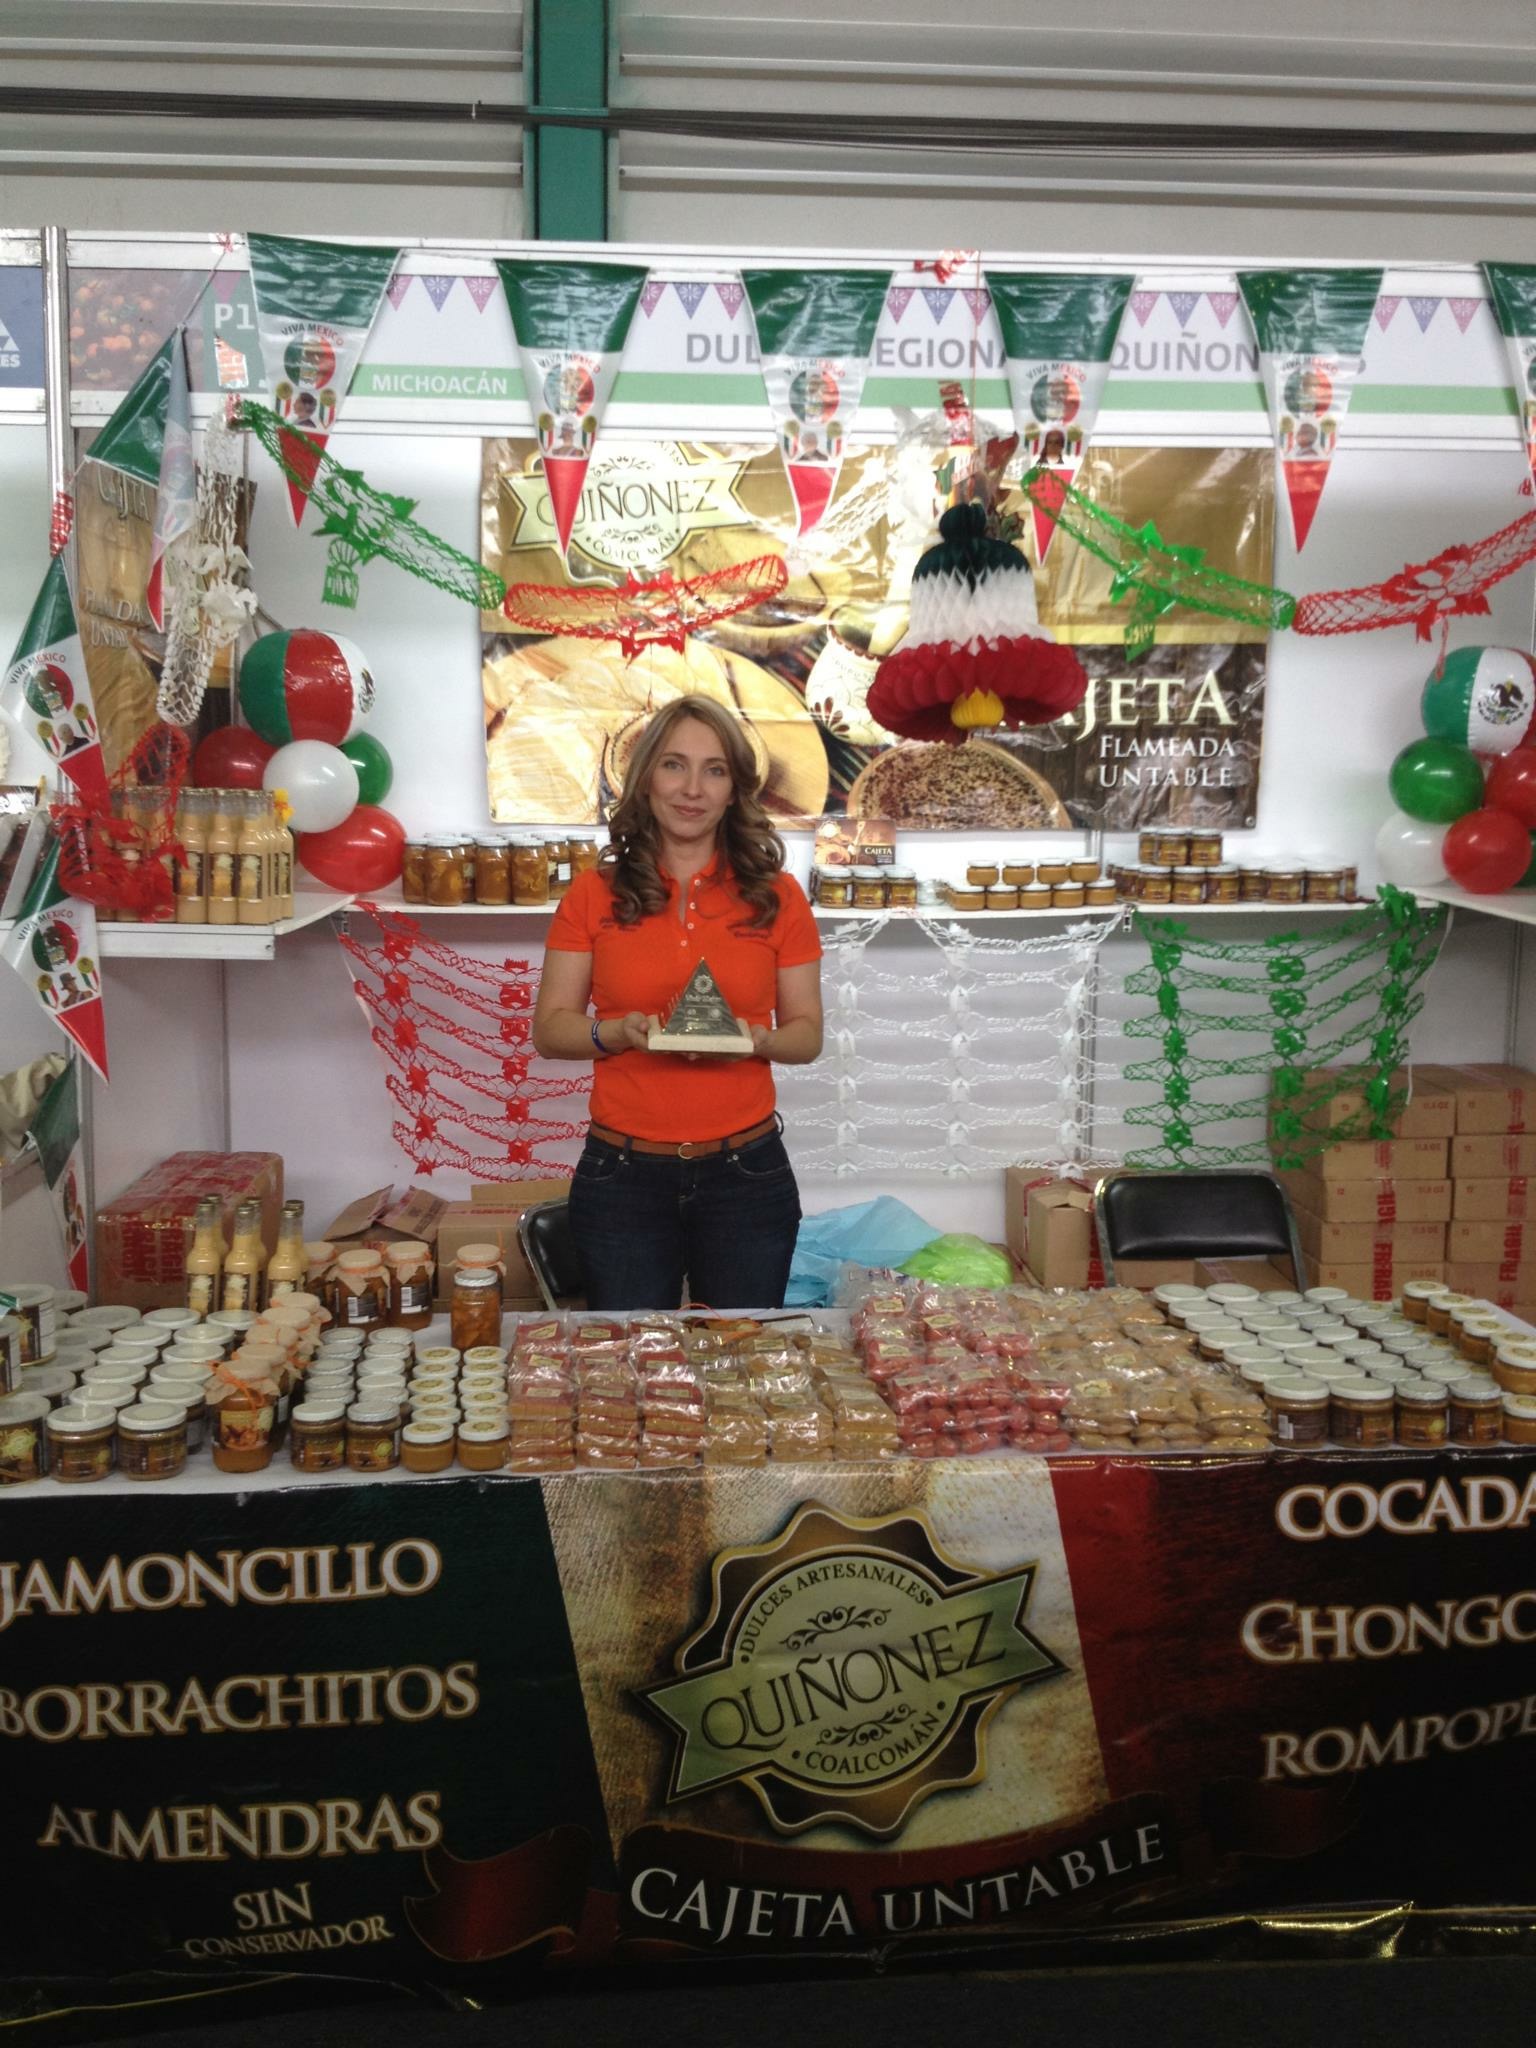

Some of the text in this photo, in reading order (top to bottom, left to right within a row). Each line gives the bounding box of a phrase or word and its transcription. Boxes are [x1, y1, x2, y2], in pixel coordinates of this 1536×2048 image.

[281, 323, 305, 336] VIVA
[371, 370, 508, 396] MICHOACÁN
[1058, 668, 1238, 742] JETA
[1099, 735, 1237, 760] FLAMEADA
[1099, 764, 1234, 788] UNTABLE
[0, 1538, 441, 1632] JAMONCILLO
[740, 1563, 929, 1654] DULCES ARTESANALES
[0, 1661, 480, 1743] BORRACHITOS
[699, 1609, 1006, 1752] QUIÑONEZ
[805, 1711, 940, 1774] COALCOMÁN
[38, 1790, 442, 1862] ALMENDRAS
[232, 1882, 313, 1931] SIN
[630, 1822, 1165, 1944] CAJETA UNTABLE
[183, 1914, 395, 1957] CONSERVADOR
